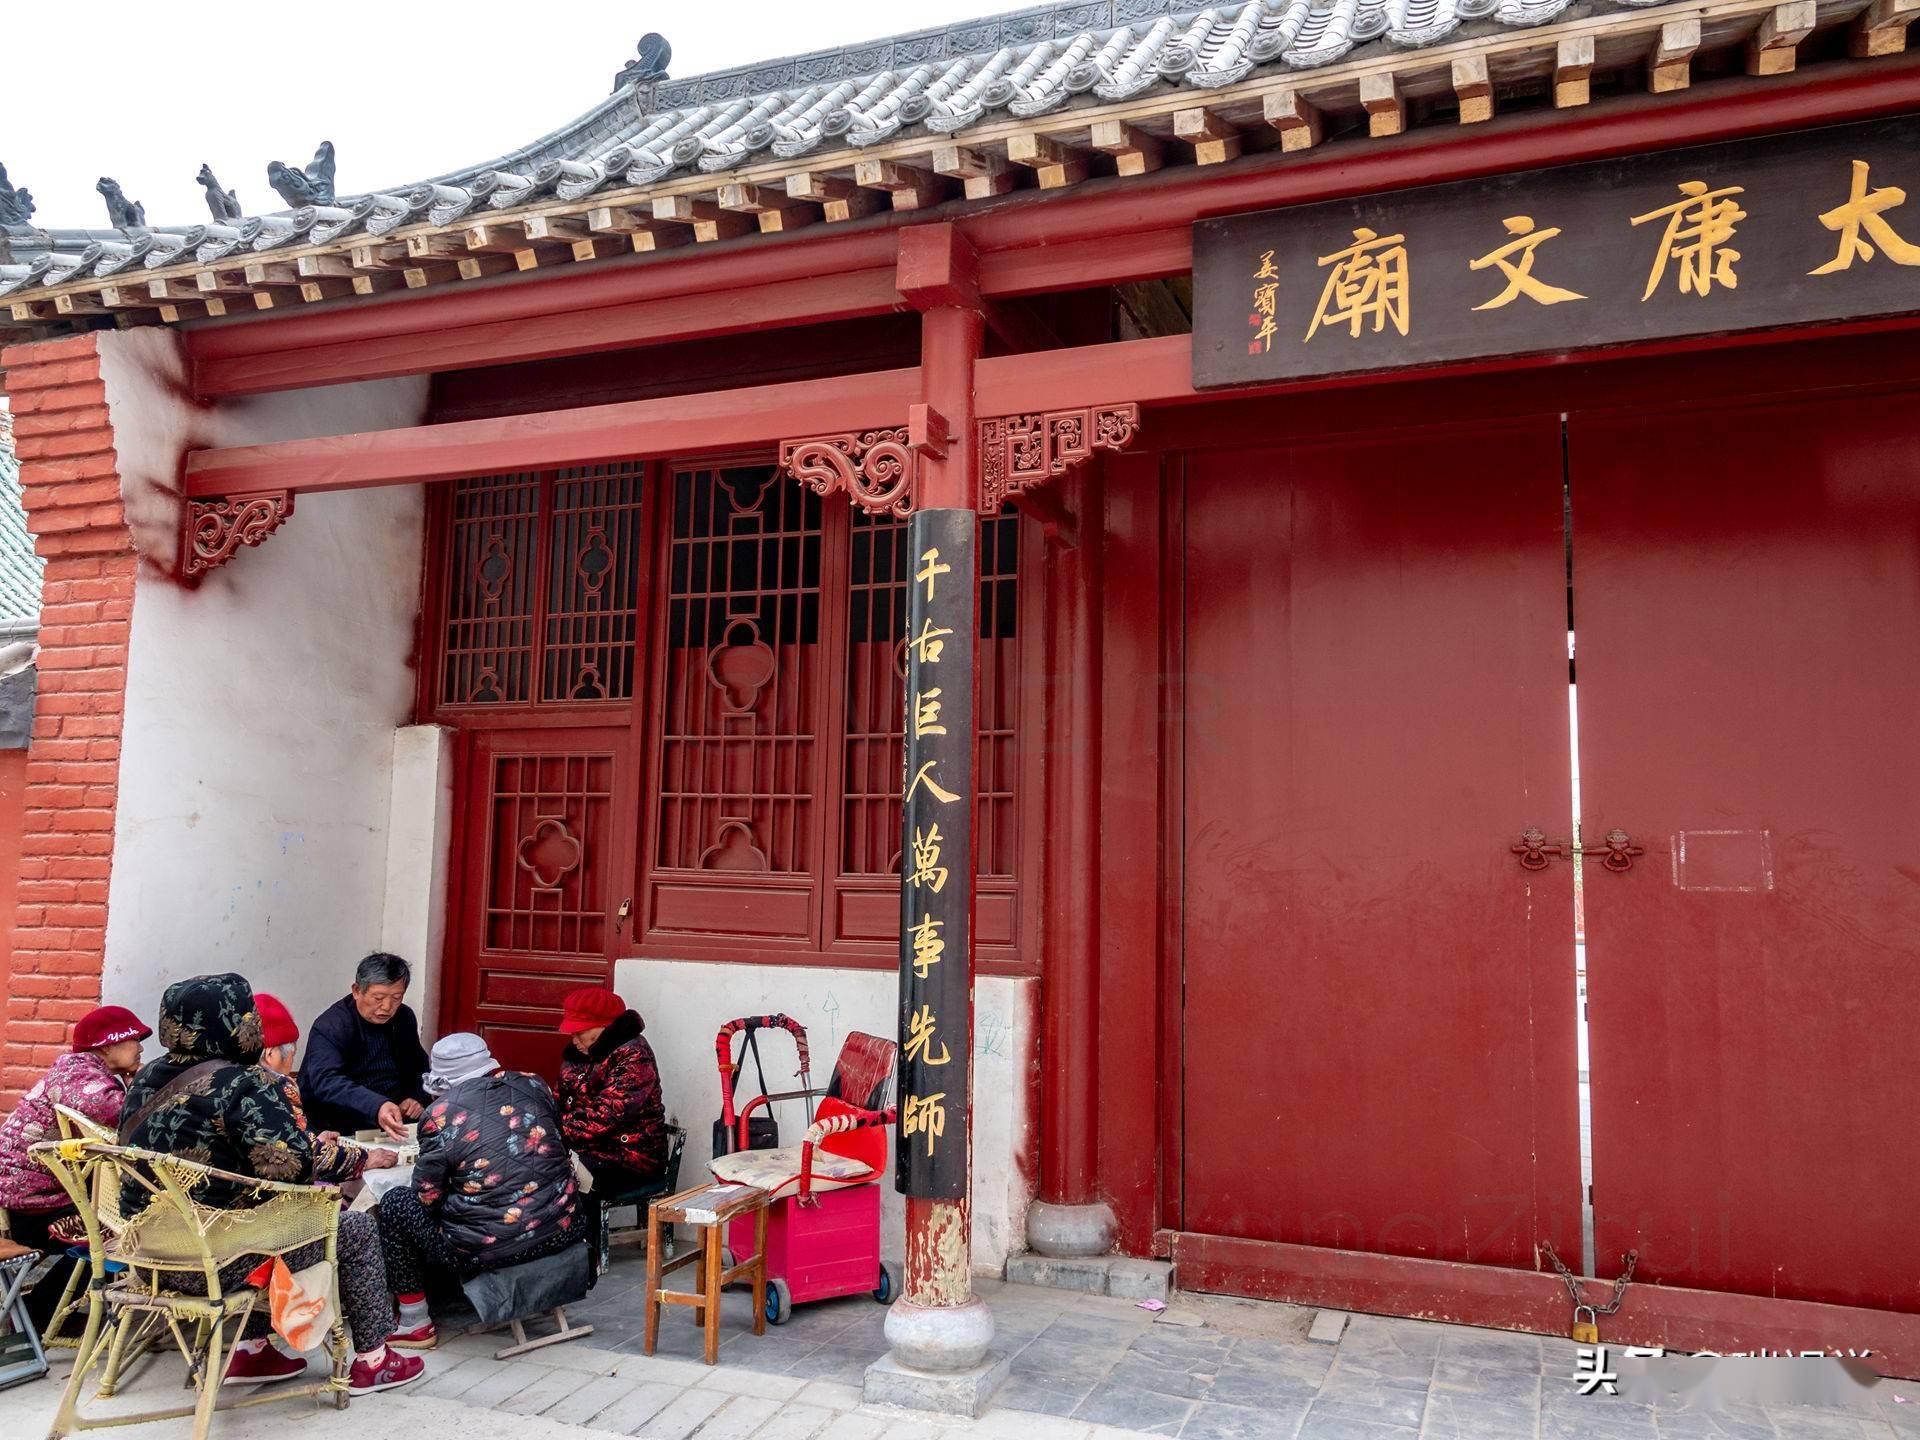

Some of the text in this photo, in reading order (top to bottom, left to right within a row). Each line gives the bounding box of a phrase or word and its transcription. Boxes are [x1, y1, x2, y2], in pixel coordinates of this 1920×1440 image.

[1304, 160, 1920, 343] 太康文廟
[108, 1027, 139, 1041] York
